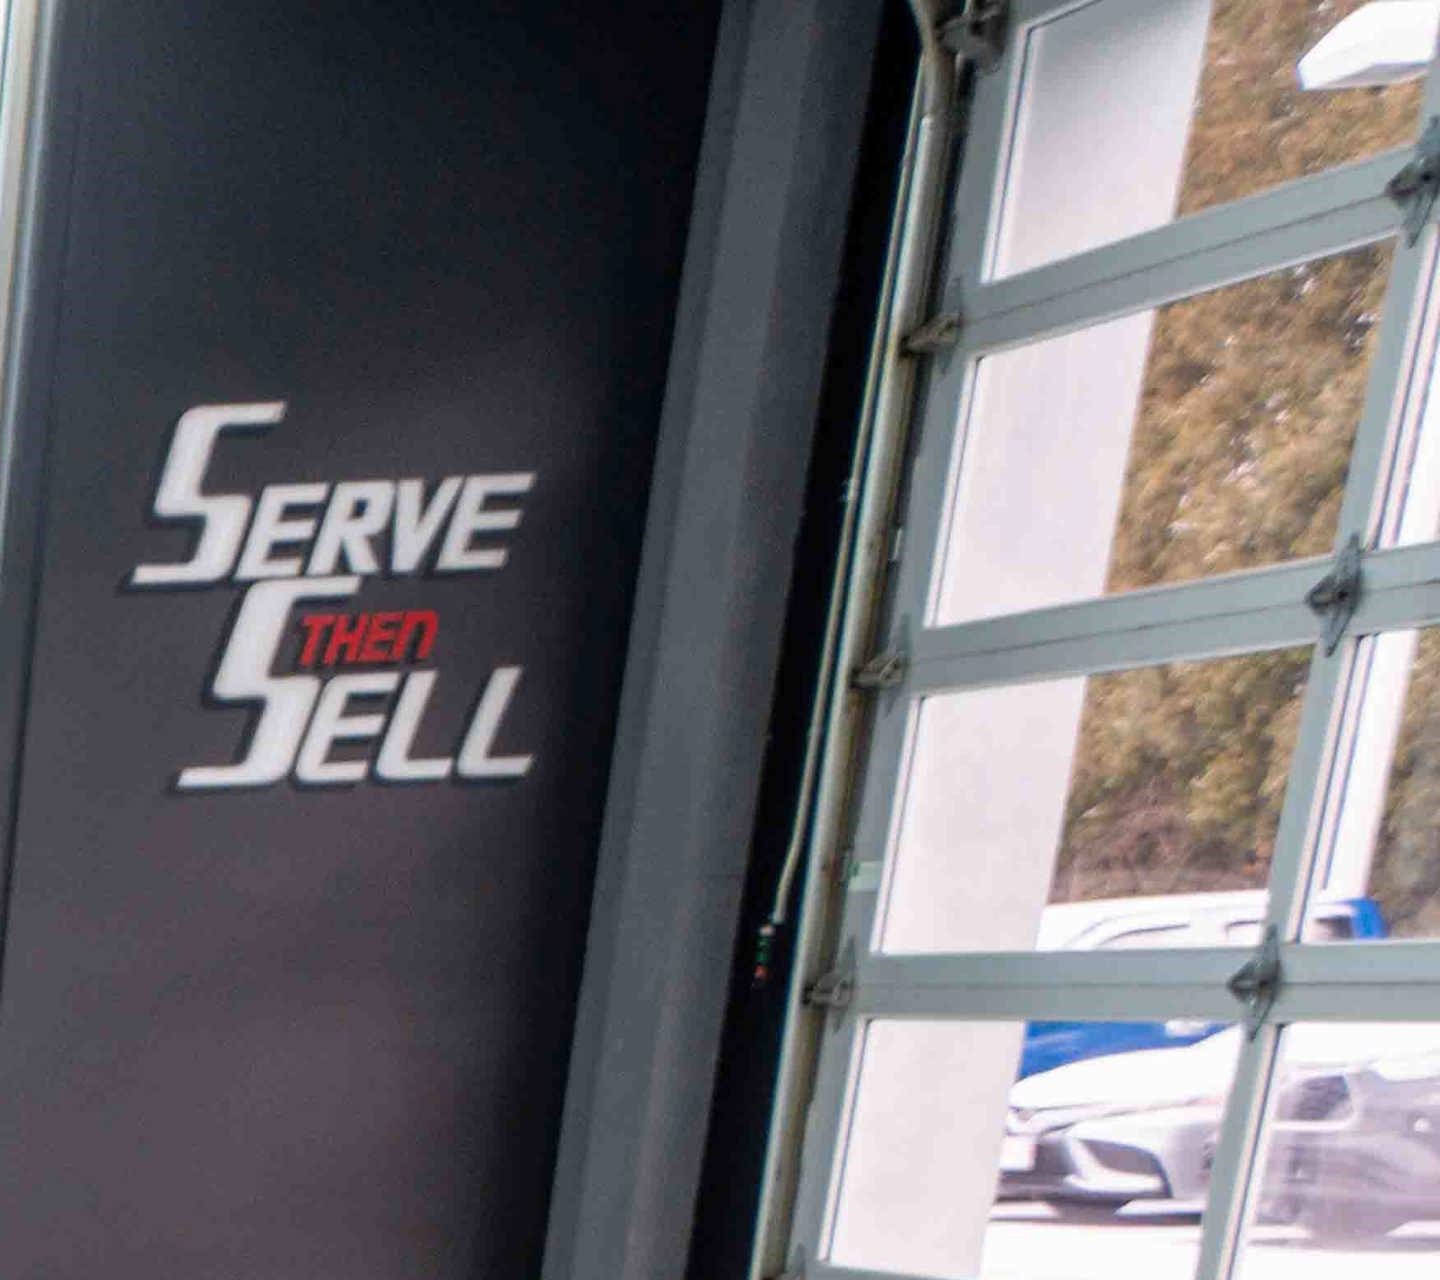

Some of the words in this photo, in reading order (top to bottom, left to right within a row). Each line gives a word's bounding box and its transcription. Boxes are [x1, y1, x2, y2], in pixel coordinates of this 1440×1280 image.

[130, 400, 537, 586] SERVE
[177, 573, 535, 788] SELL
[299, 609, 440, 666] THEN
